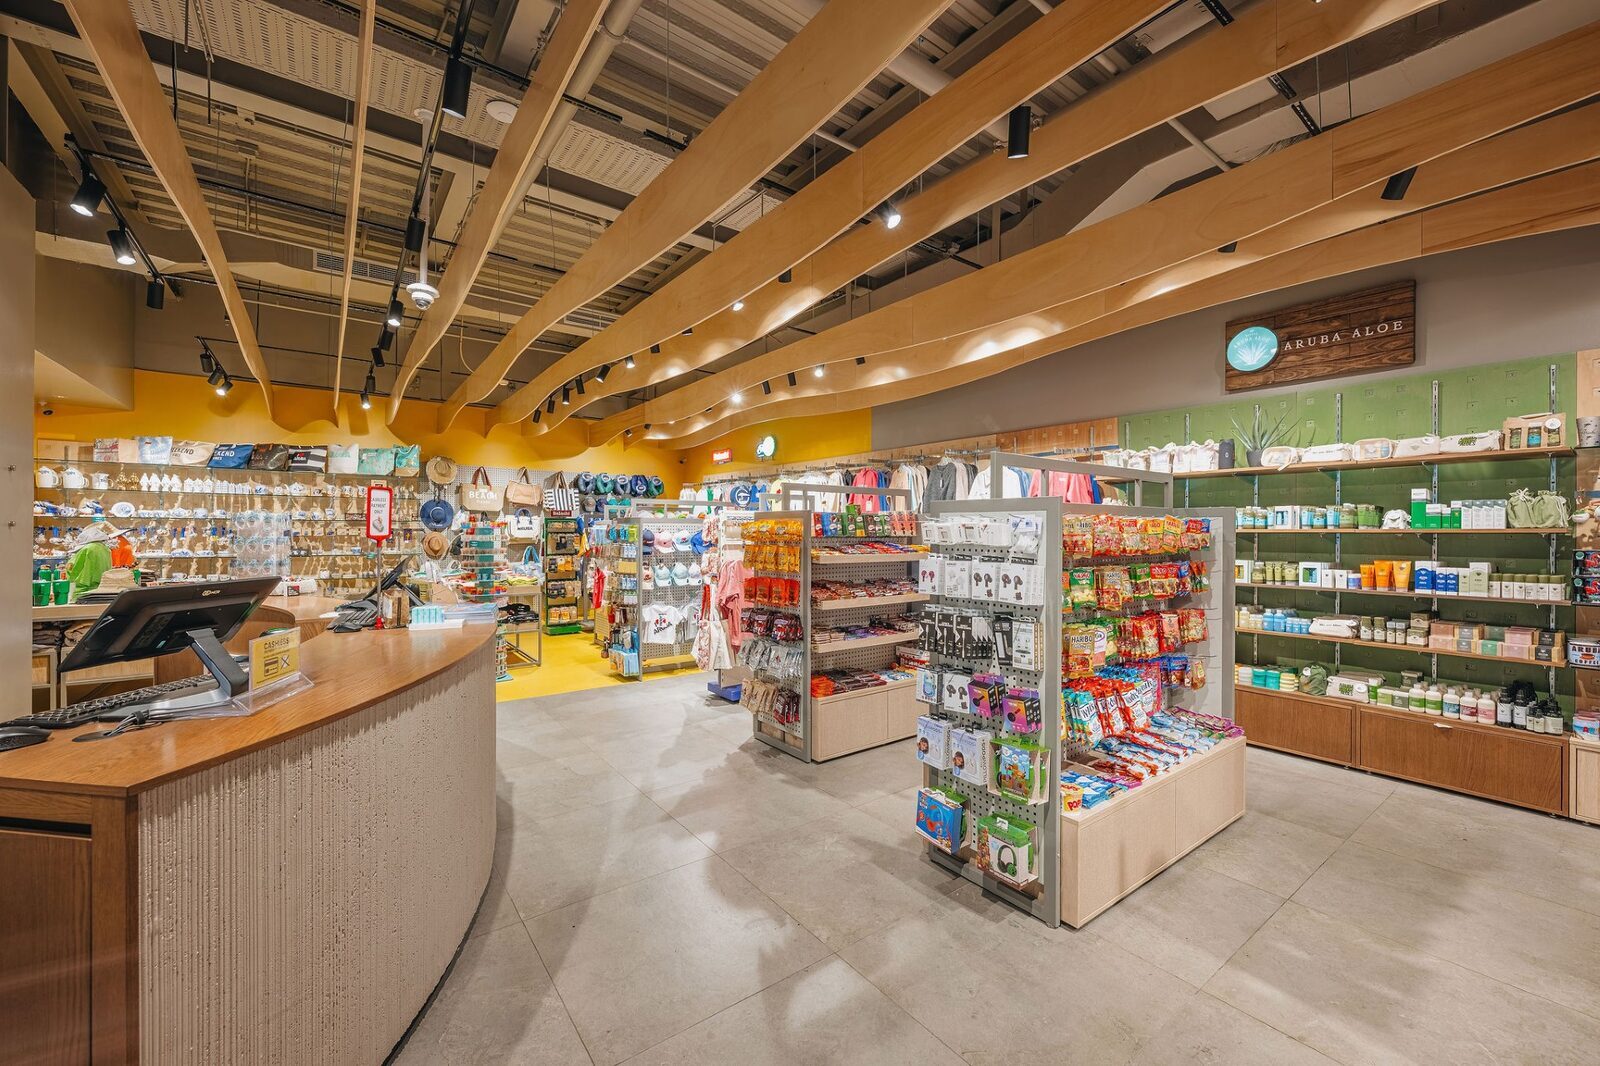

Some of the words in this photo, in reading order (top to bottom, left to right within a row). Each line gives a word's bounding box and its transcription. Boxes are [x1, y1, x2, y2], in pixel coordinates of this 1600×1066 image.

[1283, 332, 1341, 351] ARUBA
[1352, 320, 1403, 338] ALOE
[264, 637, 289, 650] CASHLESS
[1071, 635, 1093, 643] HARIBO
[1571, 645, 1600, 653] ARUB
